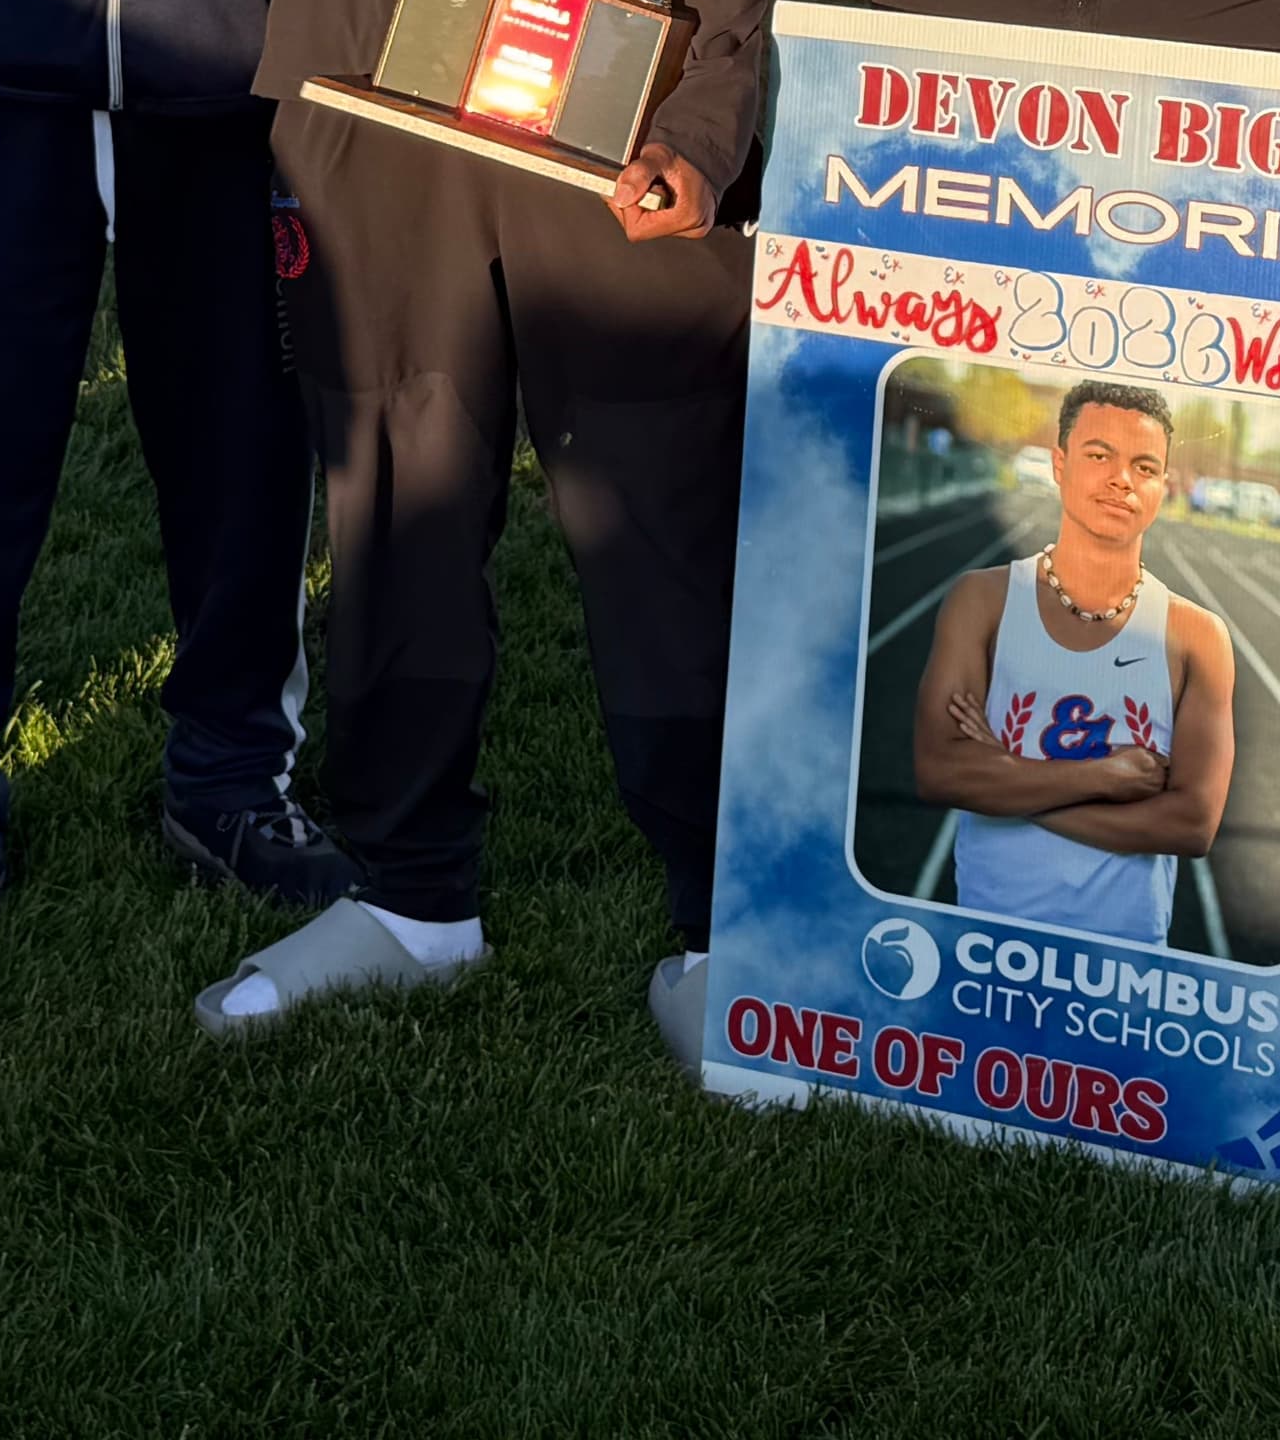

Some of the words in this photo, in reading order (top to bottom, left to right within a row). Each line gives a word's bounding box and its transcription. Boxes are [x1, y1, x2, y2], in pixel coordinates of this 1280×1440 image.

[855, 63, 1132, 159] DEVON
[755, 240, 1003, 353] Always
[1008, 271, 1231, 387] 2026
[952, 979, 1053, 1029] CITY
[1065, 1001, 1275, 1077] SCHOOLS
[955, 932, 1279, 1032] COLUMBUS
[725, 995, 862, 1080] ONE
[873, 1025, 965, 1096] OF
[974, 1046, 1168, 1143] OURS
